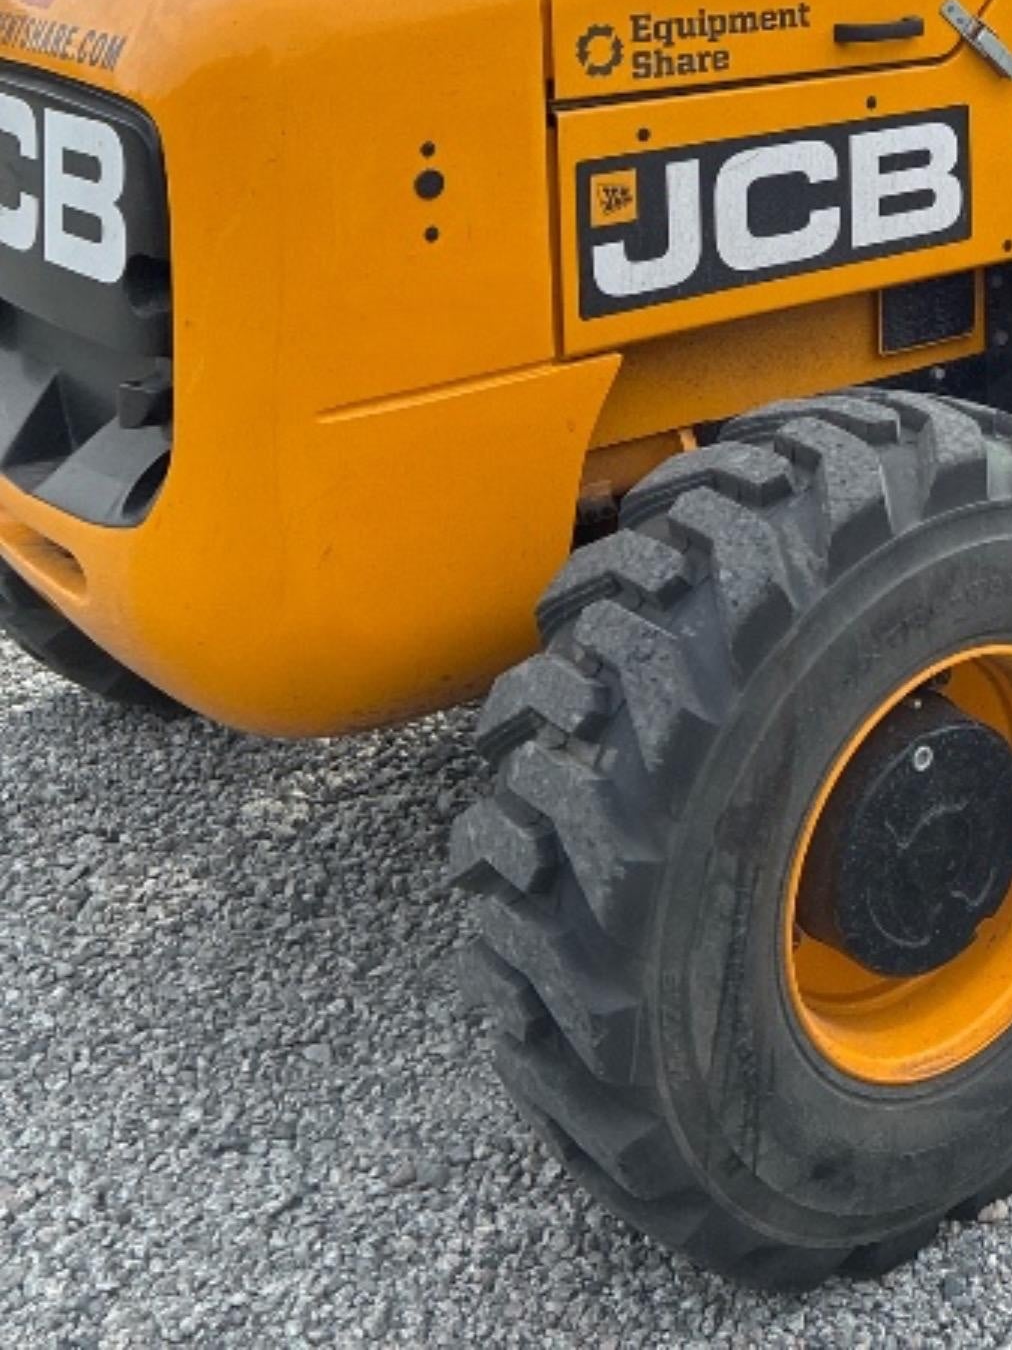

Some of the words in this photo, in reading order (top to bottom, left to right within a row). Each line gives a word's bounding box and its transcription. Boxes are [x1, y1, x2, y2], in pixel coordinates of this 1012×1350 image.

[630, 2, 810, 46] Equipment
[632, 49, 729, 79] Share
[592, 121, 963, 297] JCB
